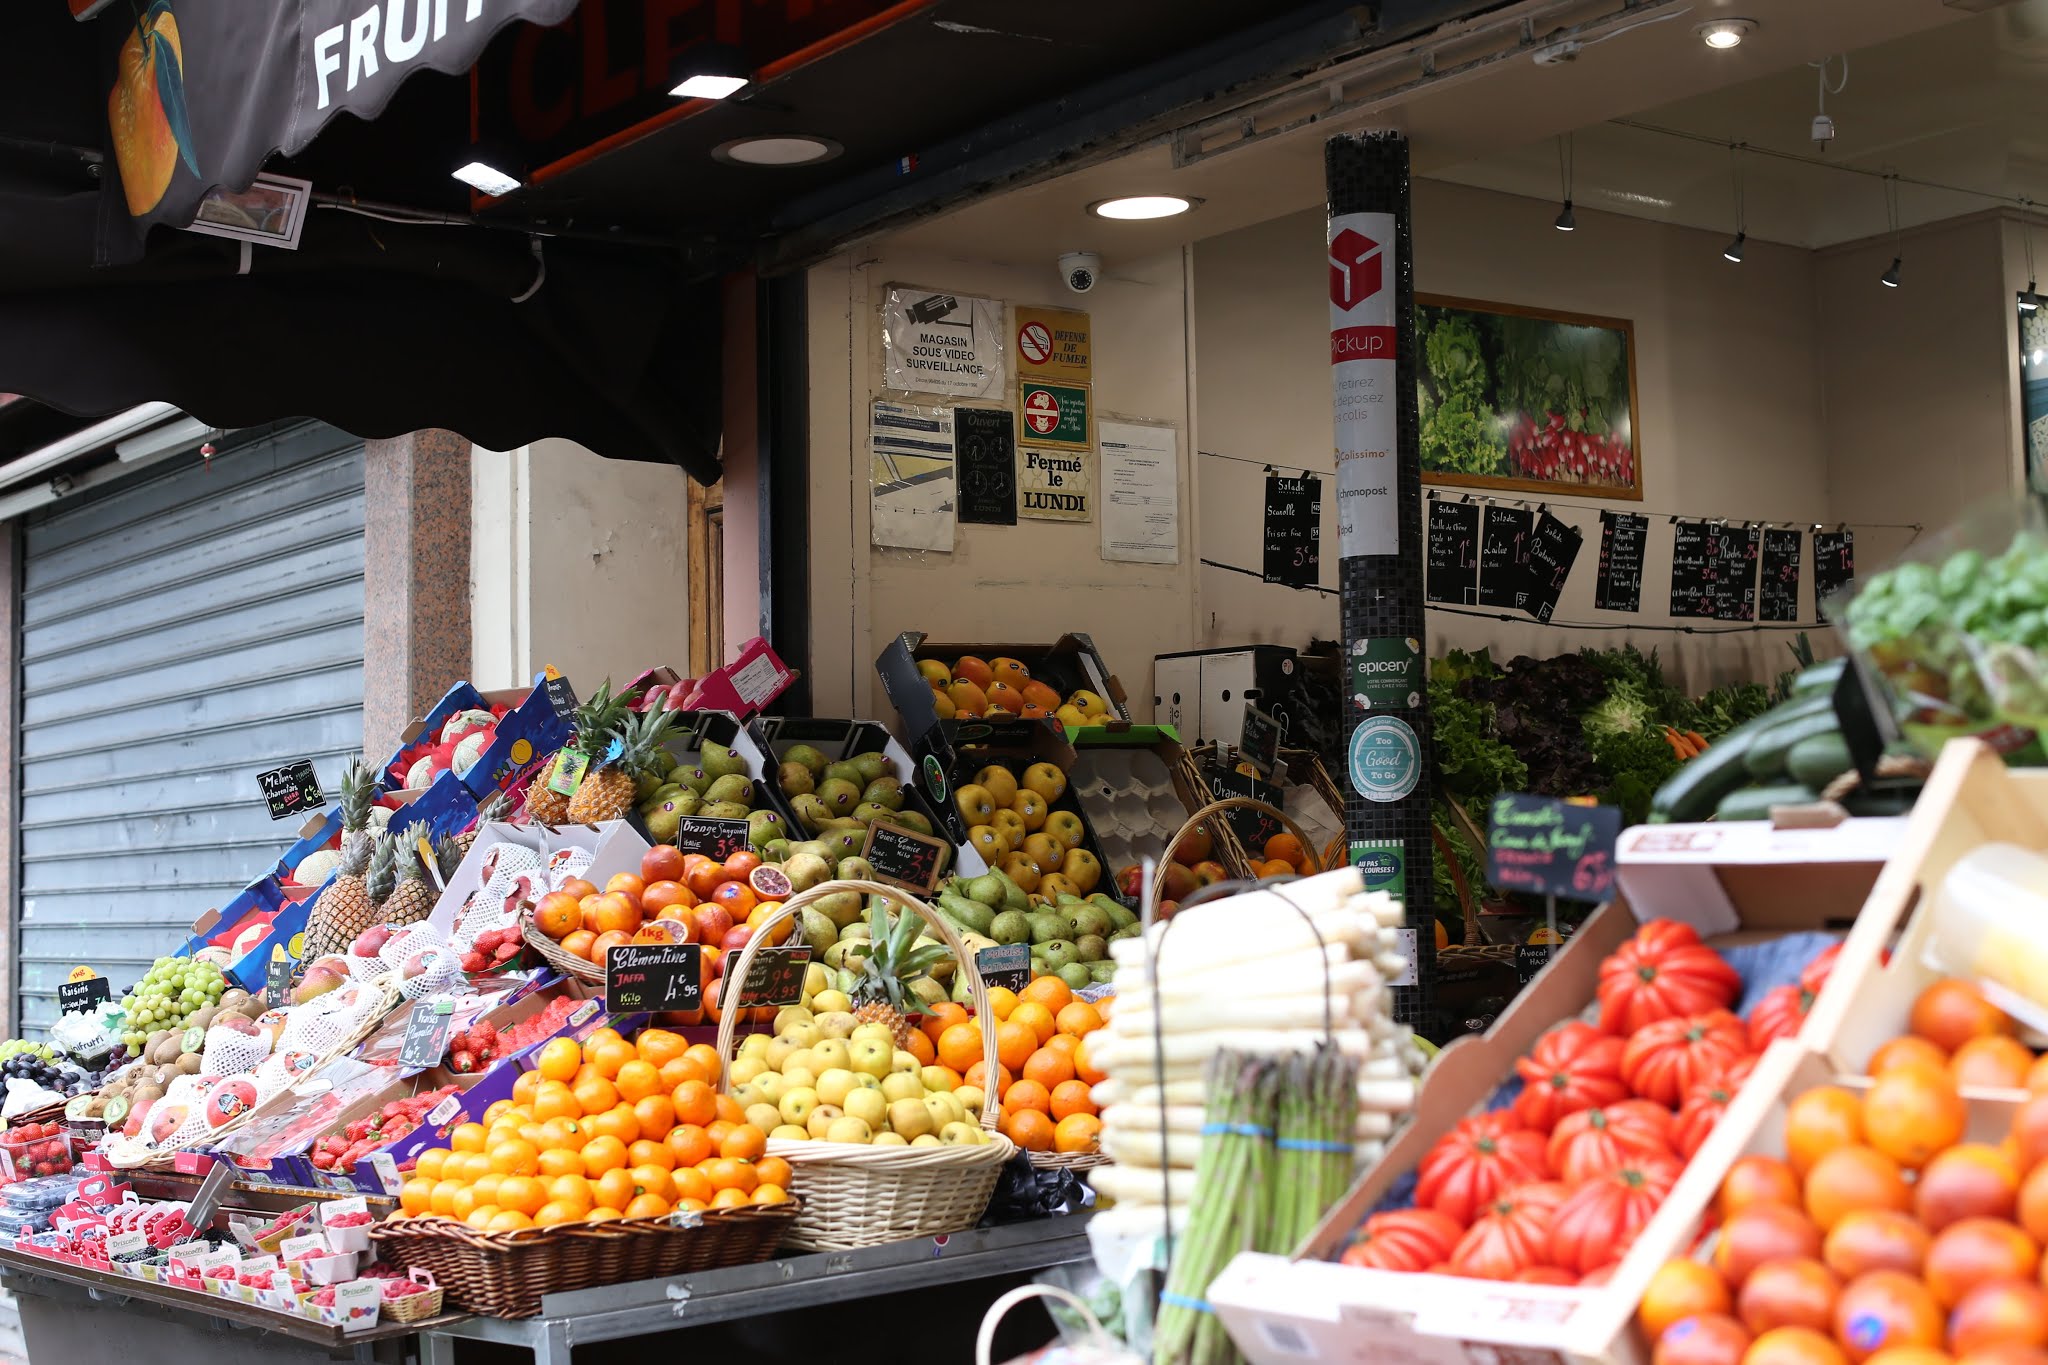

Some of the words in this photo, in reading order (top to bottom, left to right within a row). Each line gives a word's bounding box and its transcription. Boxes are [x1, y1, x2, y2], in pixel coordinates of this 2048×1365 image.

[920, 333, 967, 347] MAGASIN
[1055, 330, 1087, 343] DEFENSE
[912, 346, 942, 358] SOUS
[1063, 343, 1077, 353] DE
[1053, 352, 1087, 364] FUMER
[906, 358, 984, 375] SURVEILLANCE
[968, 414, 1000, 427] Ouvert
[1343, 409, 1368, 422] colis
[1026, 452, 1082, 472] Fermé
[1341, 450, 1385, 461] Colissimo
[1048, 470, 1063, 487] le
[1278, 480, 1304, 492] Salade
[1340, 486, 1388, 498] chronopost
[1024, 492, 1086, 512] LUNDI
[1341, 524, 1353, 536] dpd
[1719, 535, 1742, 559] Radis
[1358, 660, 1409, 676] epicery
[1365, 750, 1402, 767] Good
[683, 820, 717, 836] Orange
[641, 928, 664, 941] 1kg
[611, 946, 687, 972] Clémentine
[1520, 947, 1548, 958] Avocat
[614, 973, 645, 988] JAFFA
[1520, 973, 1527, 984] La
[620, 992, 642, 1002] Kilo
